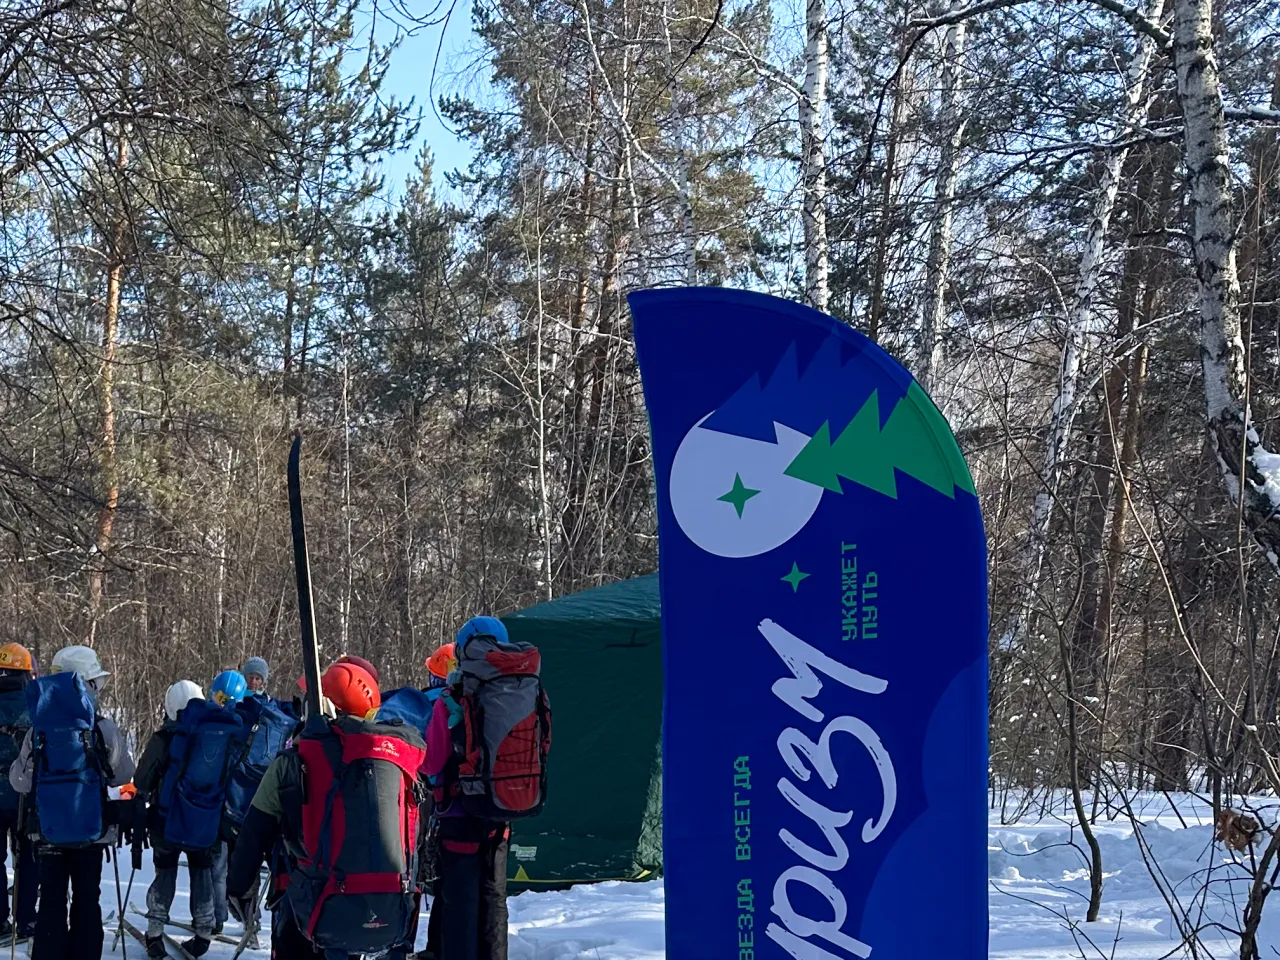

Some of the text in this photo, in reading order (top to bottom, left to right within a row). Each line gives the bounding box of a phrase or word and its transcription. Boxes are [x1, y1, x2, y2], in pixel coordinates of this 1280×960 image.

[841, 541, 858, 641] УКАЖЕТ
[862, 571, 879, 640] ПУТЬ
[0, 652, 8, 661] 12
[734, 755, 752, 861] ВСЕГДА
